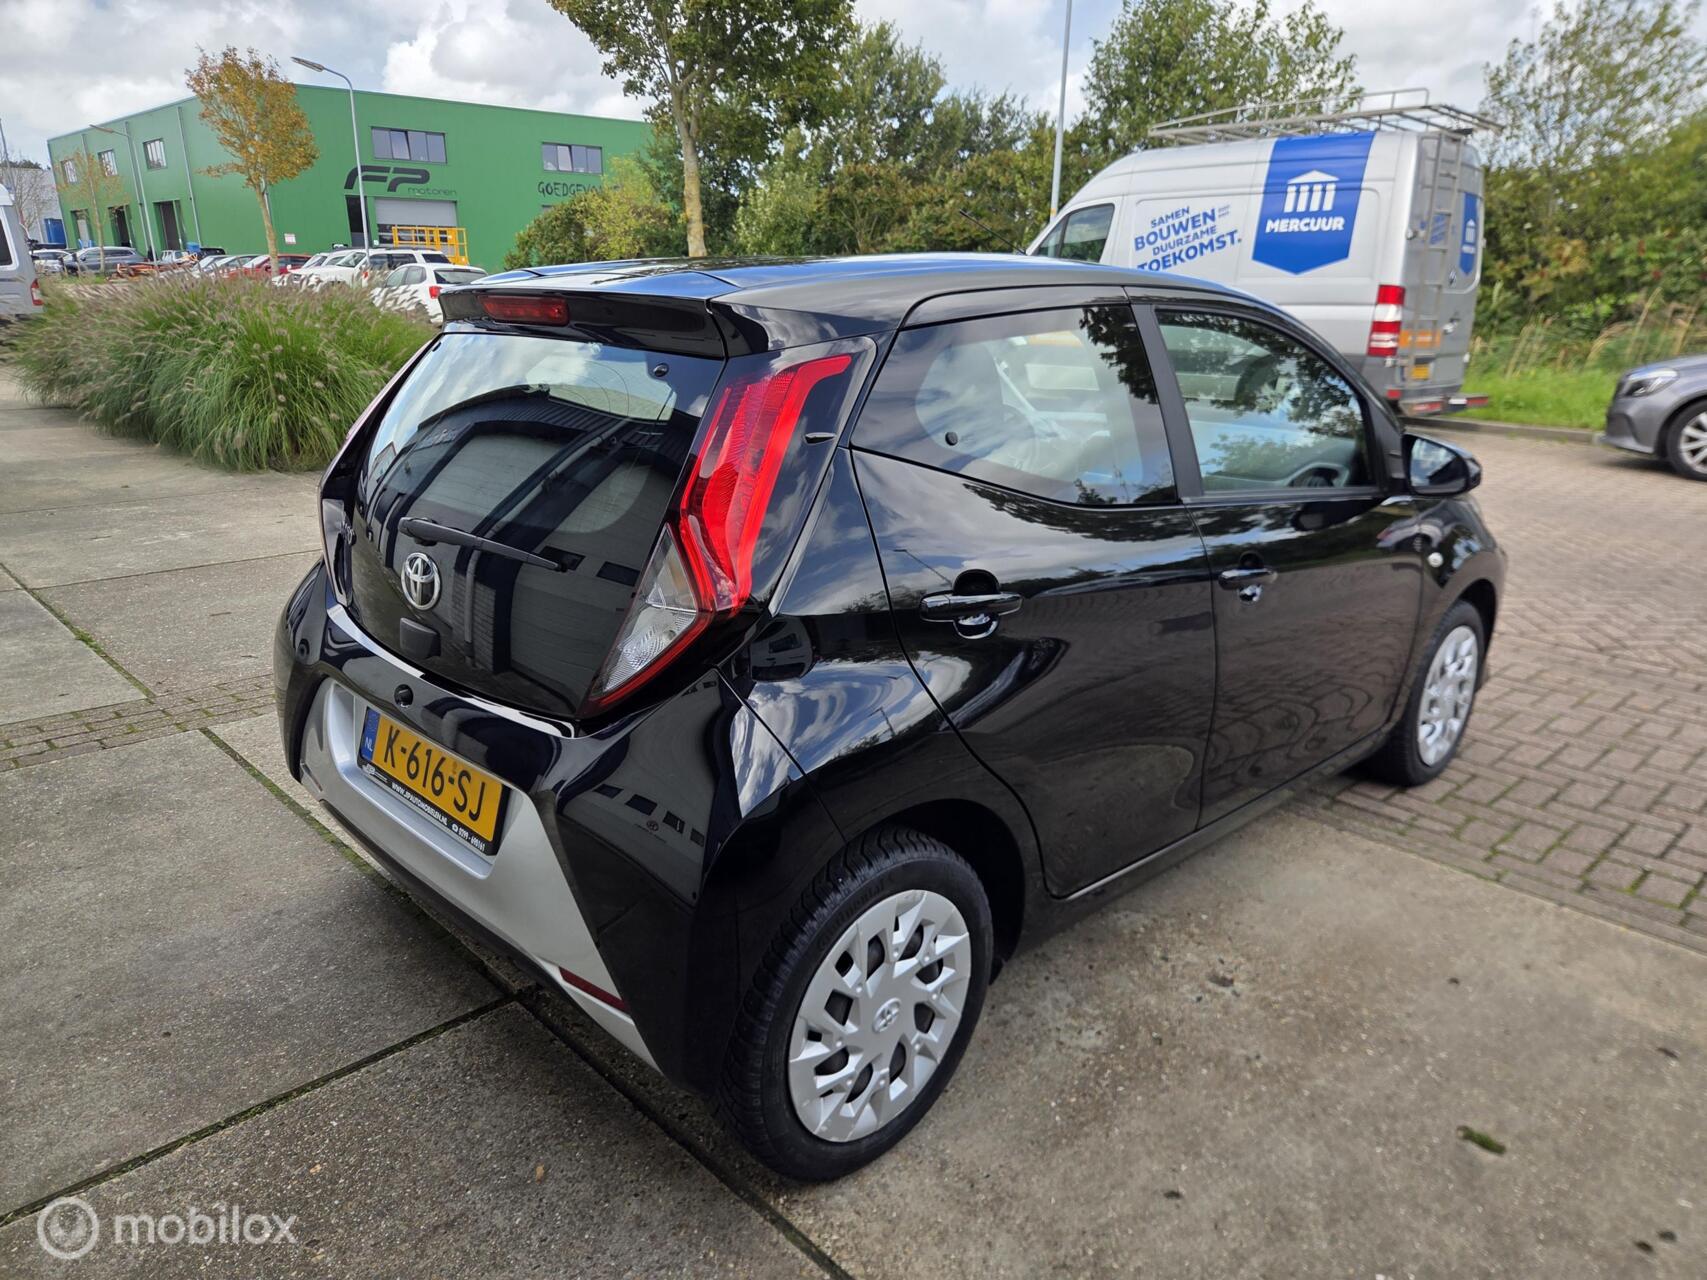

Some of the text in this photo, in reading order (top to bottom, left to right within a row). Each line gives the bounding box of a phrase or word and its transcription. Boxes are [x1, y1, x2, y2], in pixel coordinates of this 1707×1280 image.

[344, 165, 430, 192] FP
[407, 186, 457, 196] motoren
[1134, 208, 1216, 251] BOUWEN
[1151, 206, 1190, 228] SAMEN
[1265, 216, 1345, 233] MERCUUR
[1137, 230, 1242, 272] TOEKOMST.
[1153, 225, 1217, 256] DUURZAME
[364, 736, 373, 752] NL
[384, 725, 486, 822] K-616-SJ
